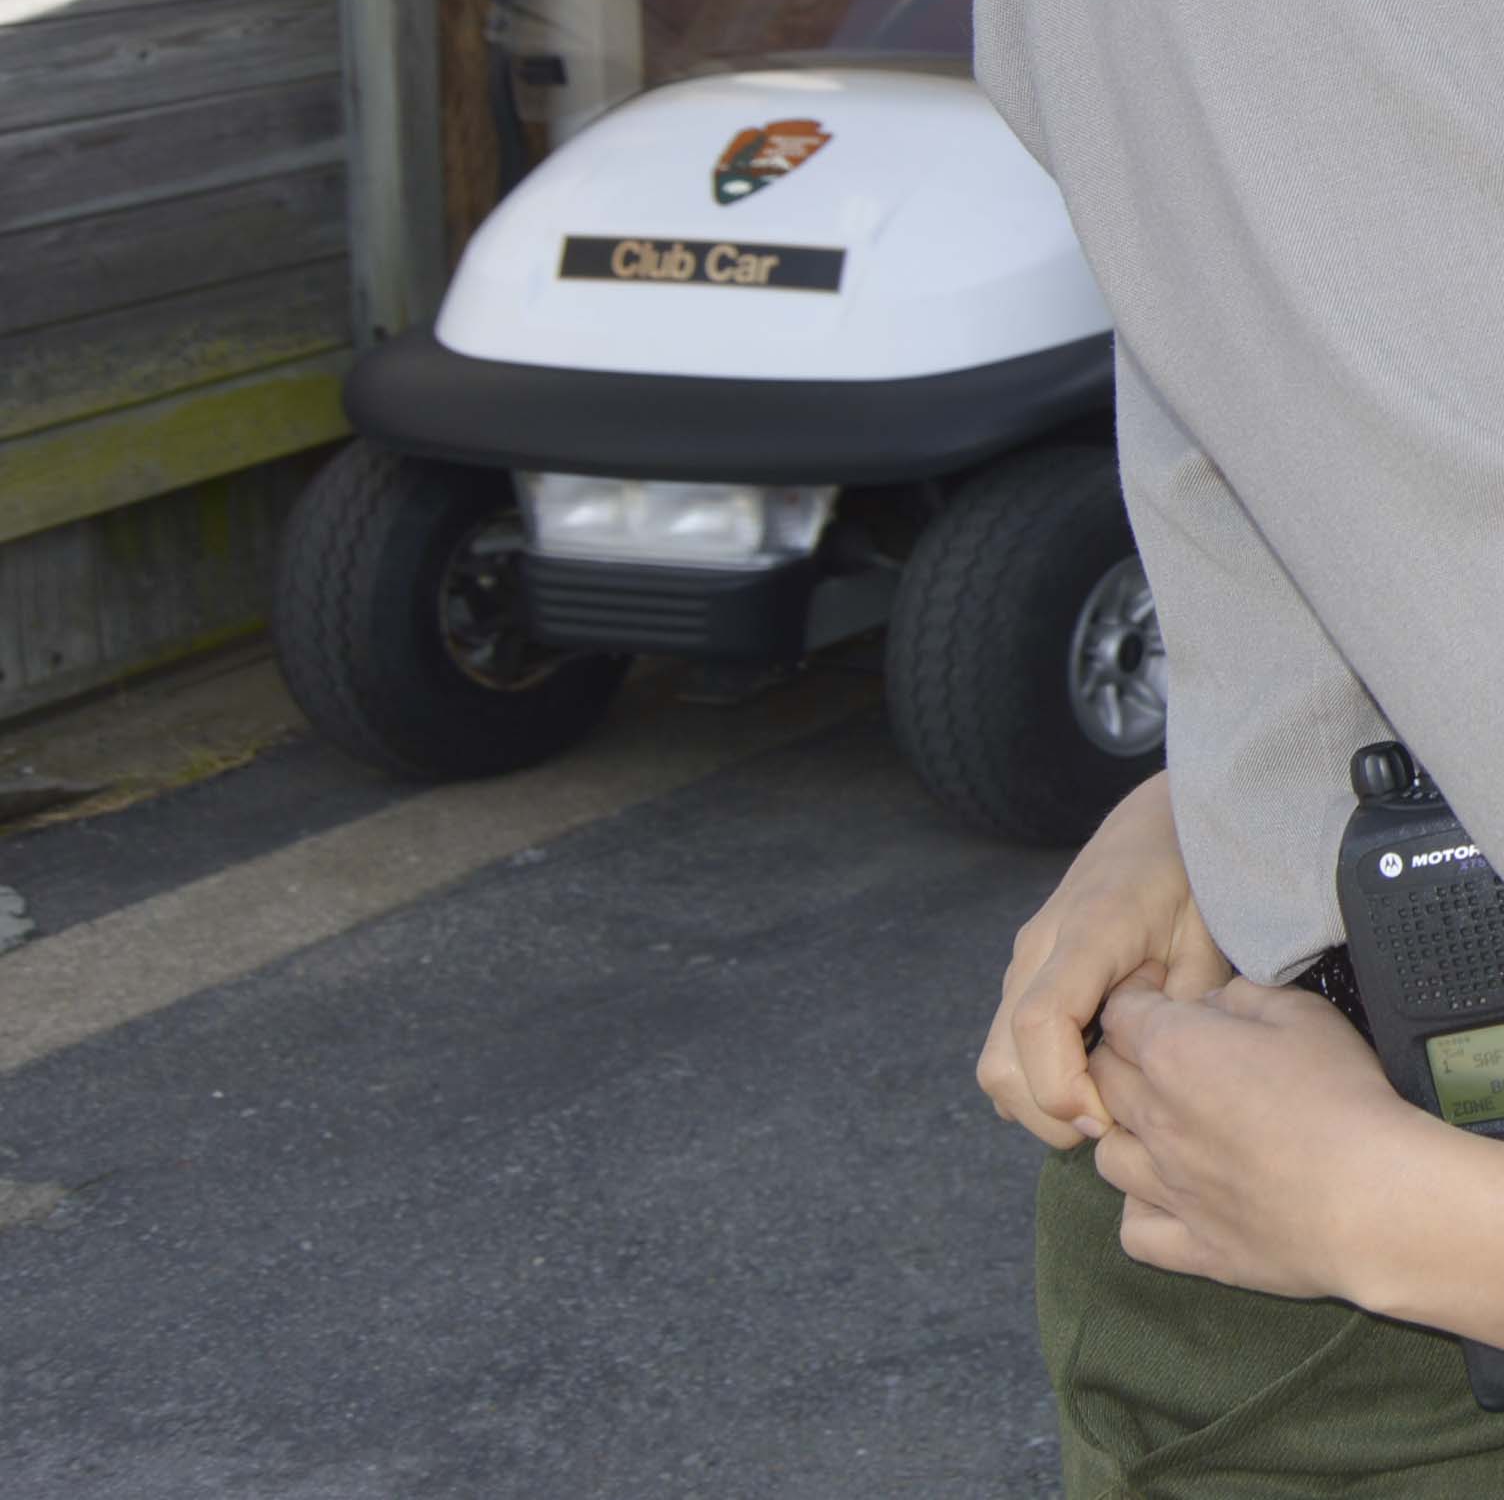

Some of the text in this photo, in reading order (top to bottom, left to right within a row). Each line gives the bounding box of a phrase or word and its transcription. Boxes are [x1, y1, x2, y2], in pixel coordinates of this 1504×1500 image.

[611, 240, 780, 285] Club Car
[1453, 1098, 1497, 1122] ZONE
